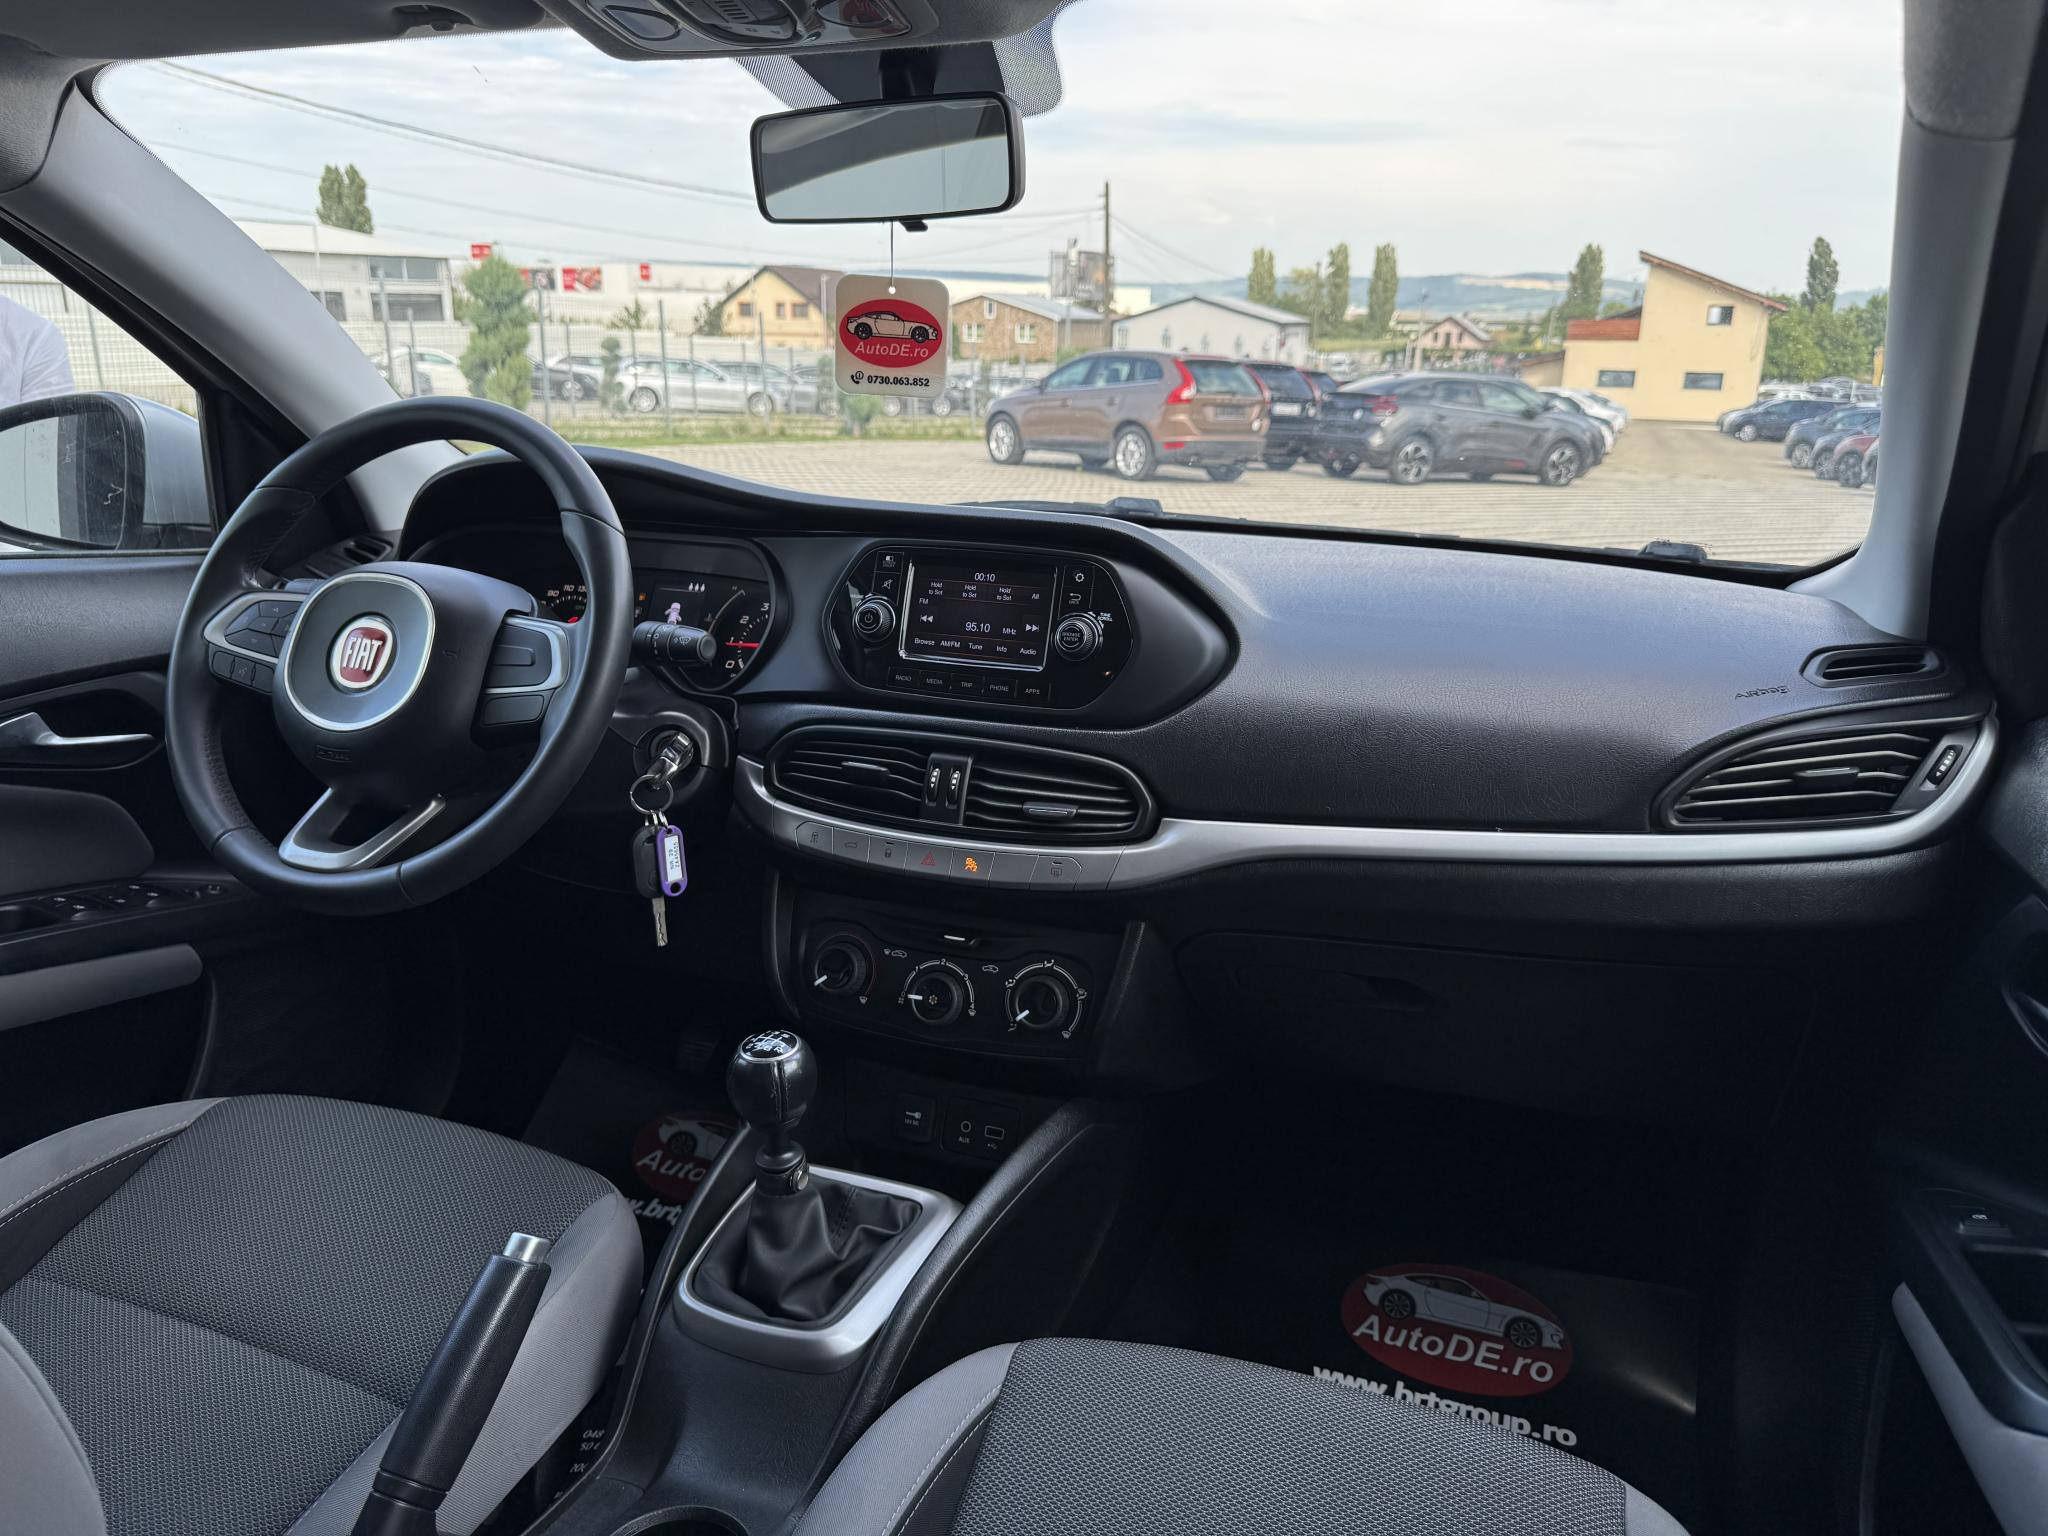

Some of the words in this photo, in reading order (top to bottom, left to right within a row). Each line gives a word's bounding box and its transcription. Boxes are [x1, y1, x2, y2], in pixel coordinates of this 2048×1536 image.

[854, 341, 929, 358] AutoDE.ro
[867, 374, 930, 387] 0730.063.852
[974, 572, 996, 582] 00:10
[965, 621, 991, 633] 95.10
[1002, 627, 1017, 635] MHz
[914, 638, 935, 646] Browse
[940, 640, 961, 648] AM/FM
[968, 642, 983, 650] Tune
[342, 636, 384, 671] FIAT
[1019, 648, 1037, 656] Audio
[895, 674, 912, 682] RADIO
[926, 677, 943, 685] MEDIA
[989, 684, 1009, 692] PHONE
[1353, 1314, 1554, 1384] AutoDE.ro
[1313, 1366, 1578, 1446] wwwbrtgroup.ro
